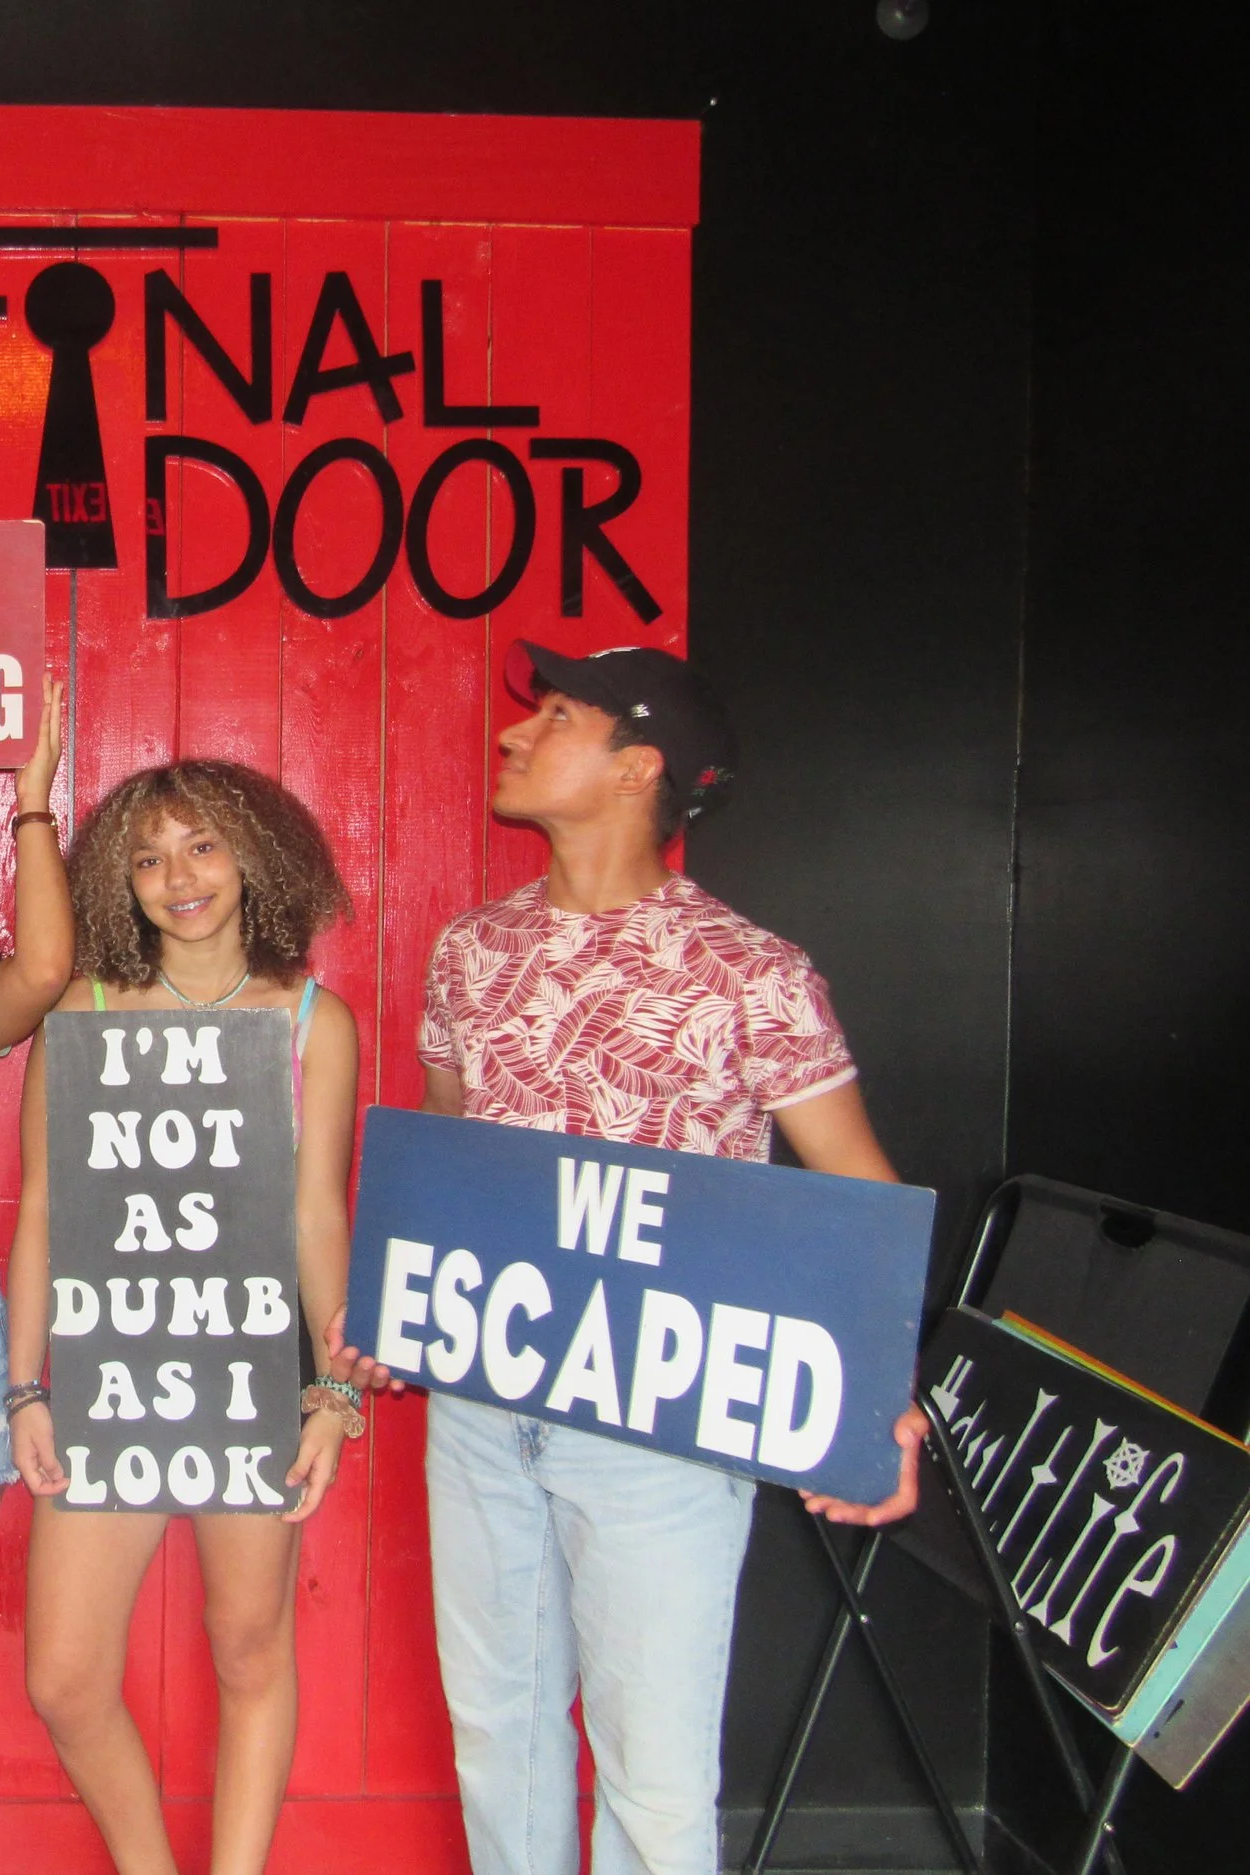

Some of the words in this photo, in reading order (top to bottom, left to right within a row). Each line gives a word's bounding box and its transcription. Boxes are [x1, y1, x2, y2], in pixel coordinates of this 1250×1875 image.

[145, 434, 664, 625] DOOR
[100, 1026, 227, 1085] I'M
[87, 1109, 244, 1170] NOT
[113, 1192, 219, 1252] AS
[557, 1156, 670, 1266] WE
[51, 1276, 291, 1336] DUMB
[376, 1237, 843, 1472] ESCAPED
[88, 1361, 197, 1421] AS
[226, 1361, 258, 1421] I
[65, 1445, 285, 1506] LOOK
